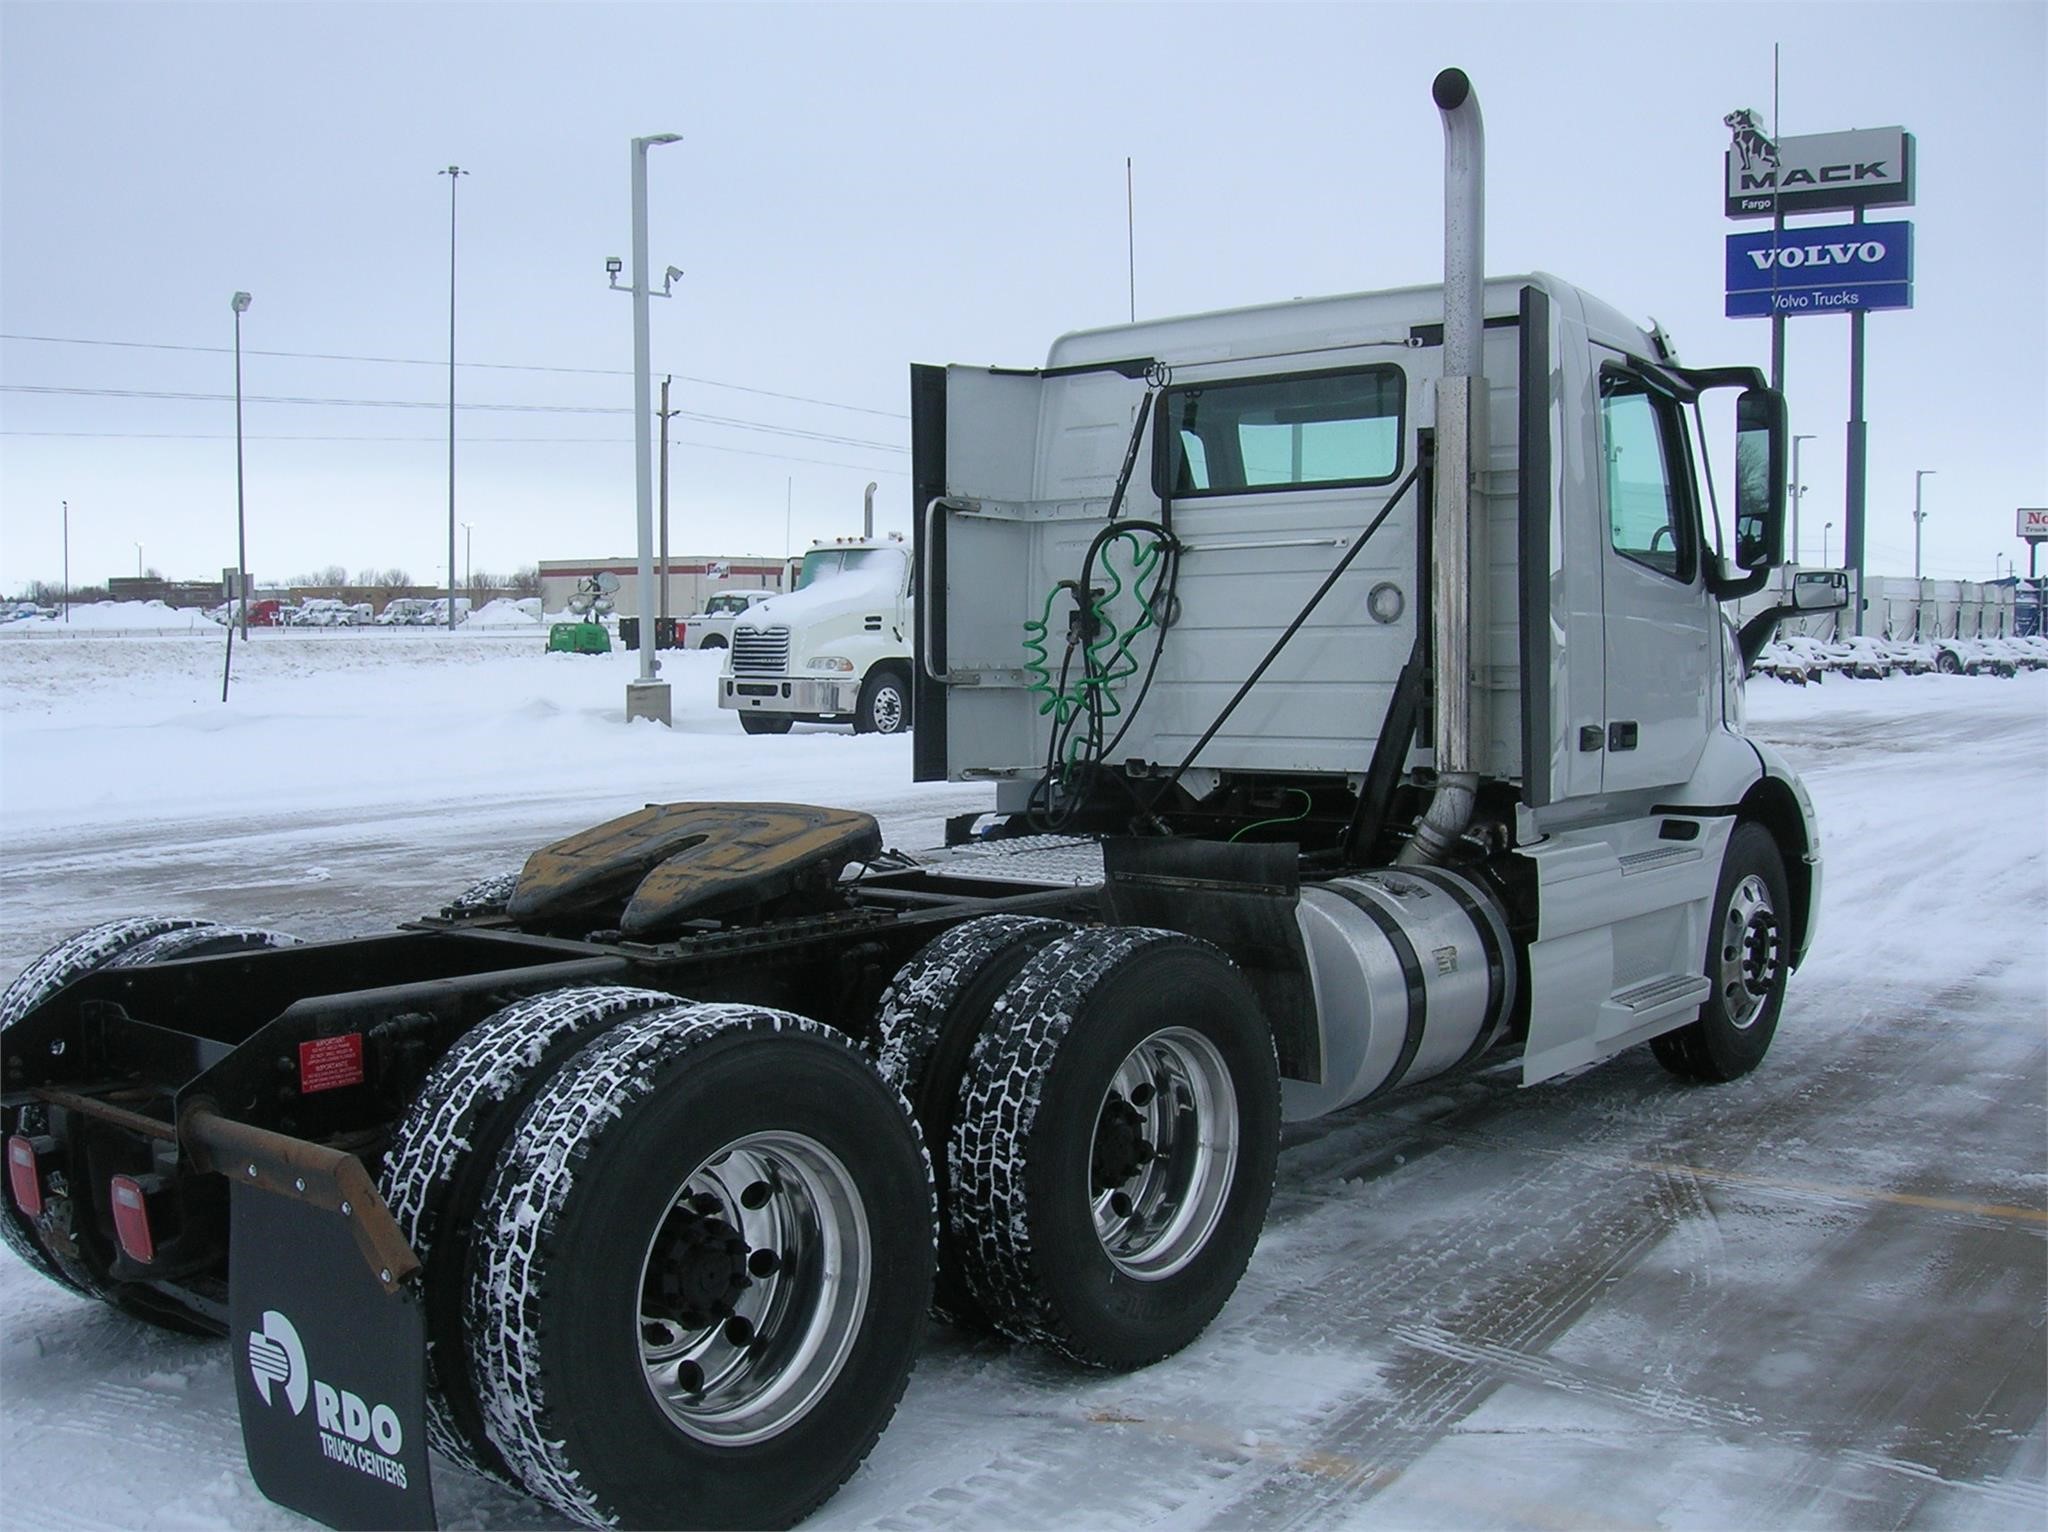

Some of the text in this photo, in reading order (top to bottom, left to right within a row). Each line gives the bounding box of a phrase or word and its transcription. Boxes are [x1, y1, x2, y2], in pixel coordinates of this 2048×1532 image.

[1741, 161, 1887, 190] MACK
[1742, 199, 1771, 209] Fargo
[1747, 241, 1886, 270] VOLVO
[1772, 291, 1858, 308] Volvo Trucks
[314, 1379, 402, 1455] RDO
[320, 1431, 408, 1489] TRUCK CENTERS
